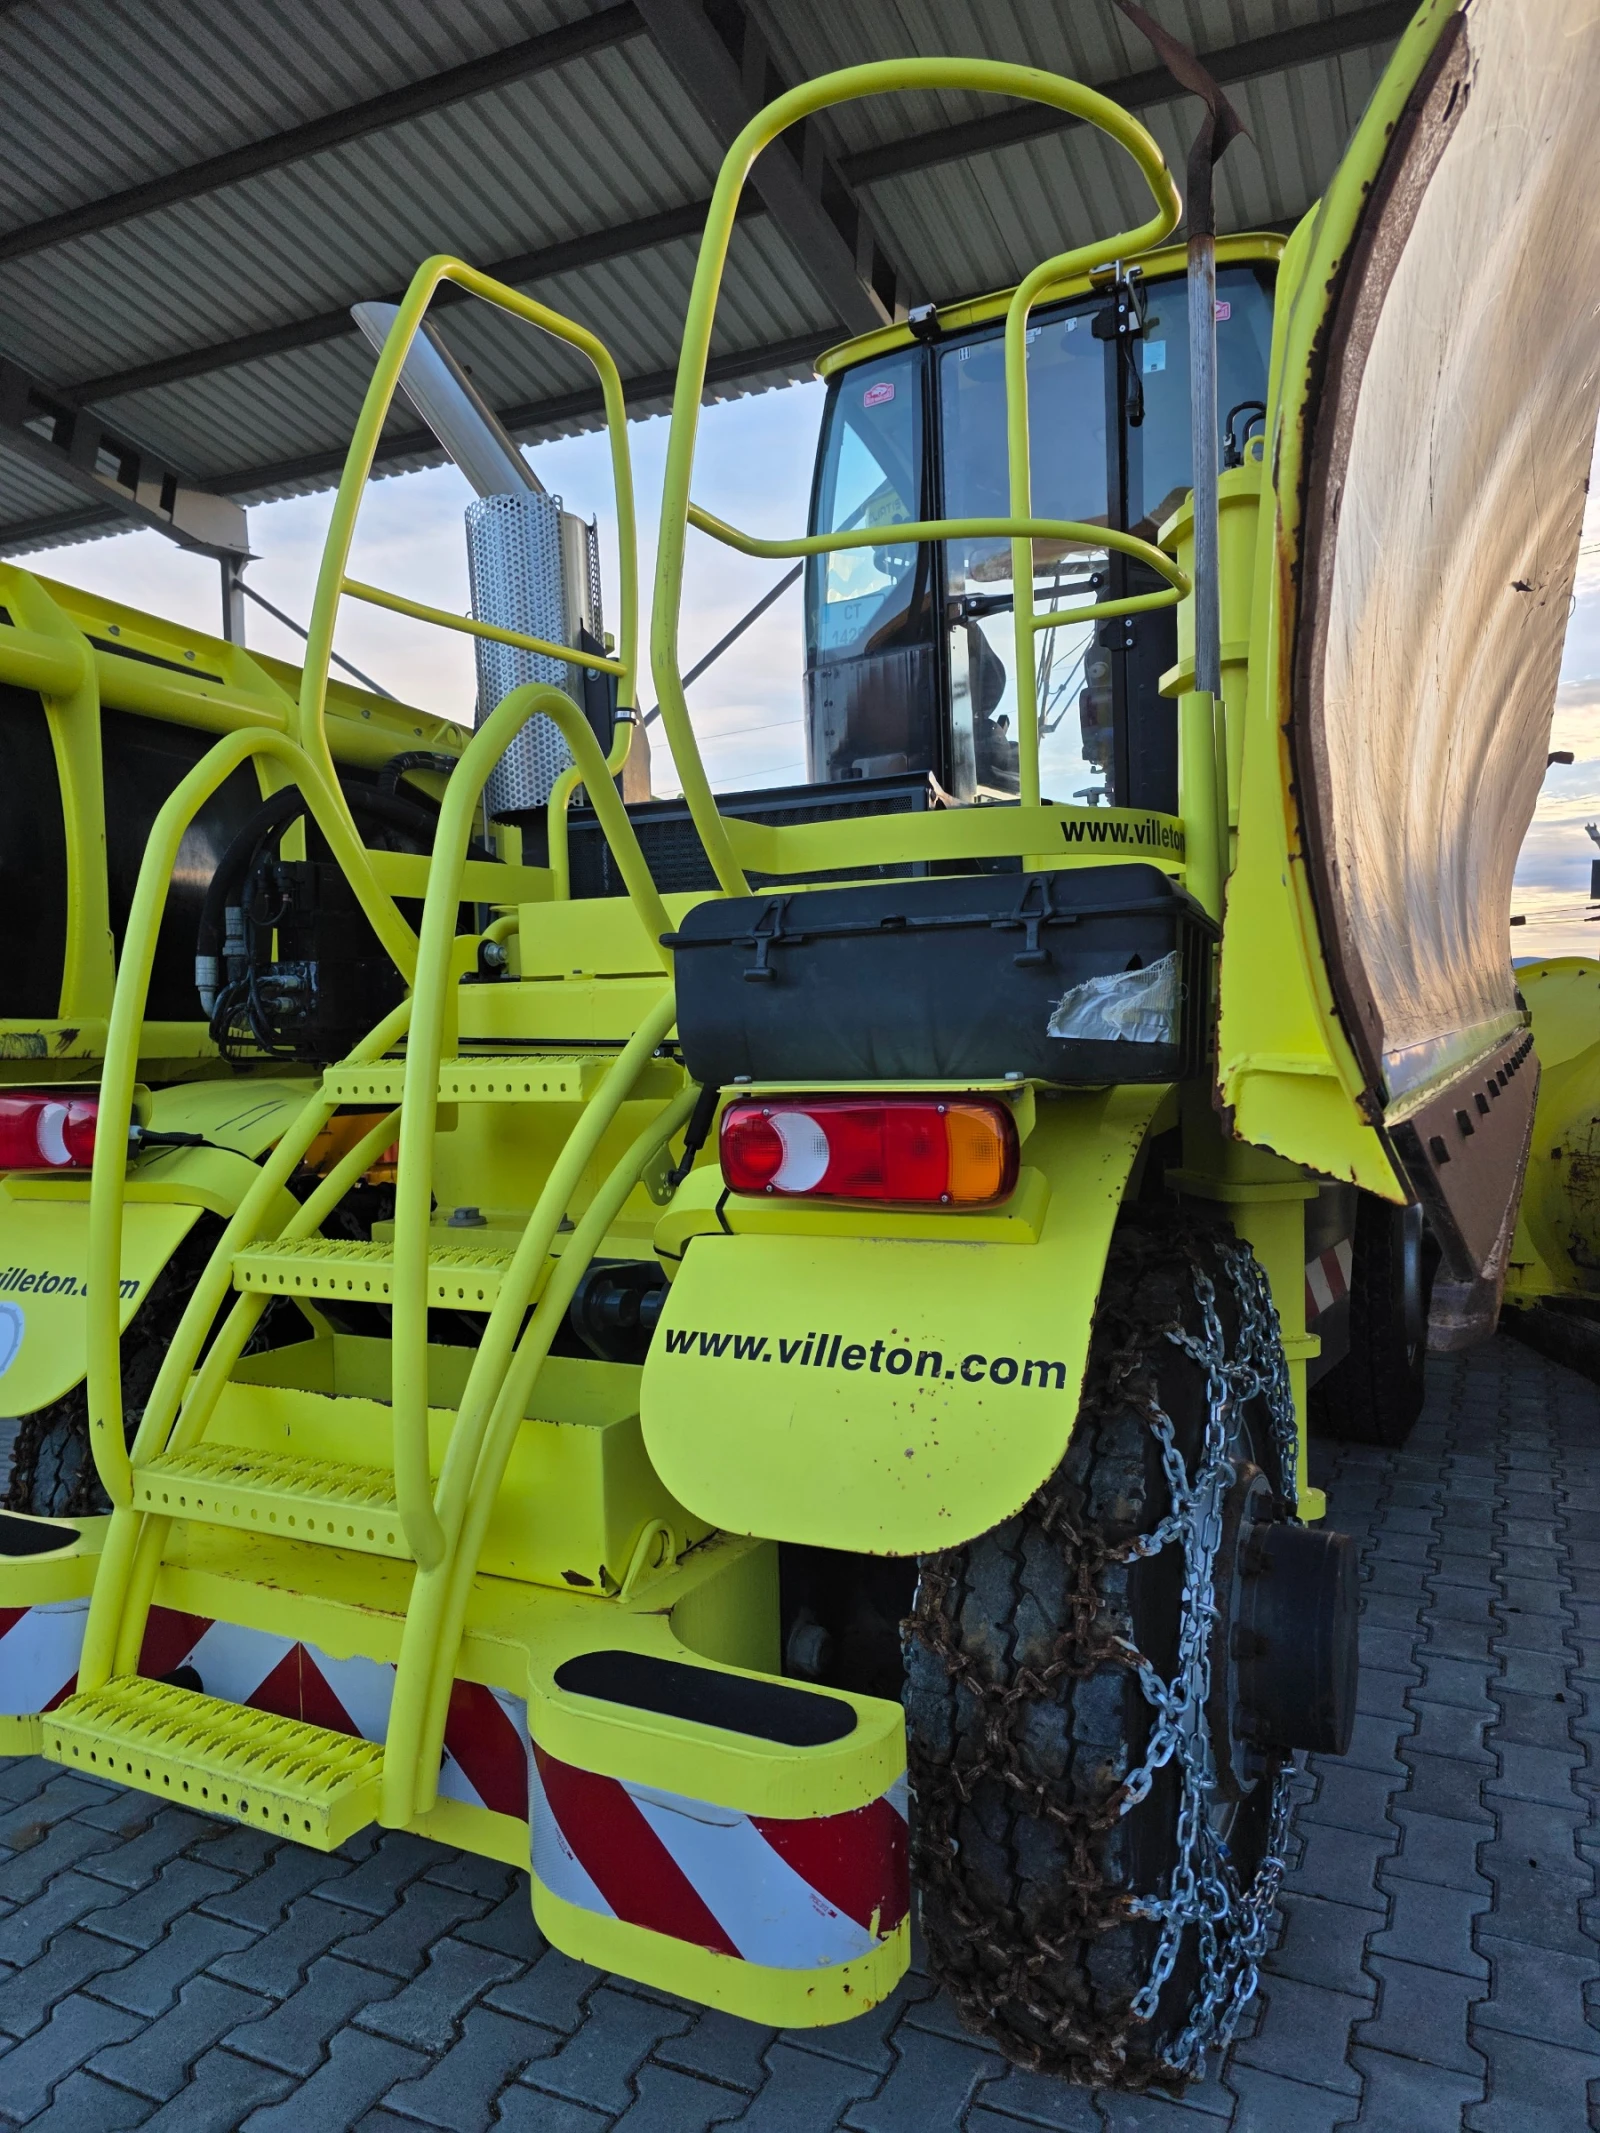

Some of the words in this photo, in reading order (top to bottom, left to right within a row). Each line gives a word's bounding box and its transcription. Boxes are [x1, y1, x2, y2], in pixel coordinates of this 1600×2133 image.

[844, 603, 862, 620] CT
[0, 1266, 140, 1299] illeton.m
[665, 1329, 1067, 1389] www.villeton.com
